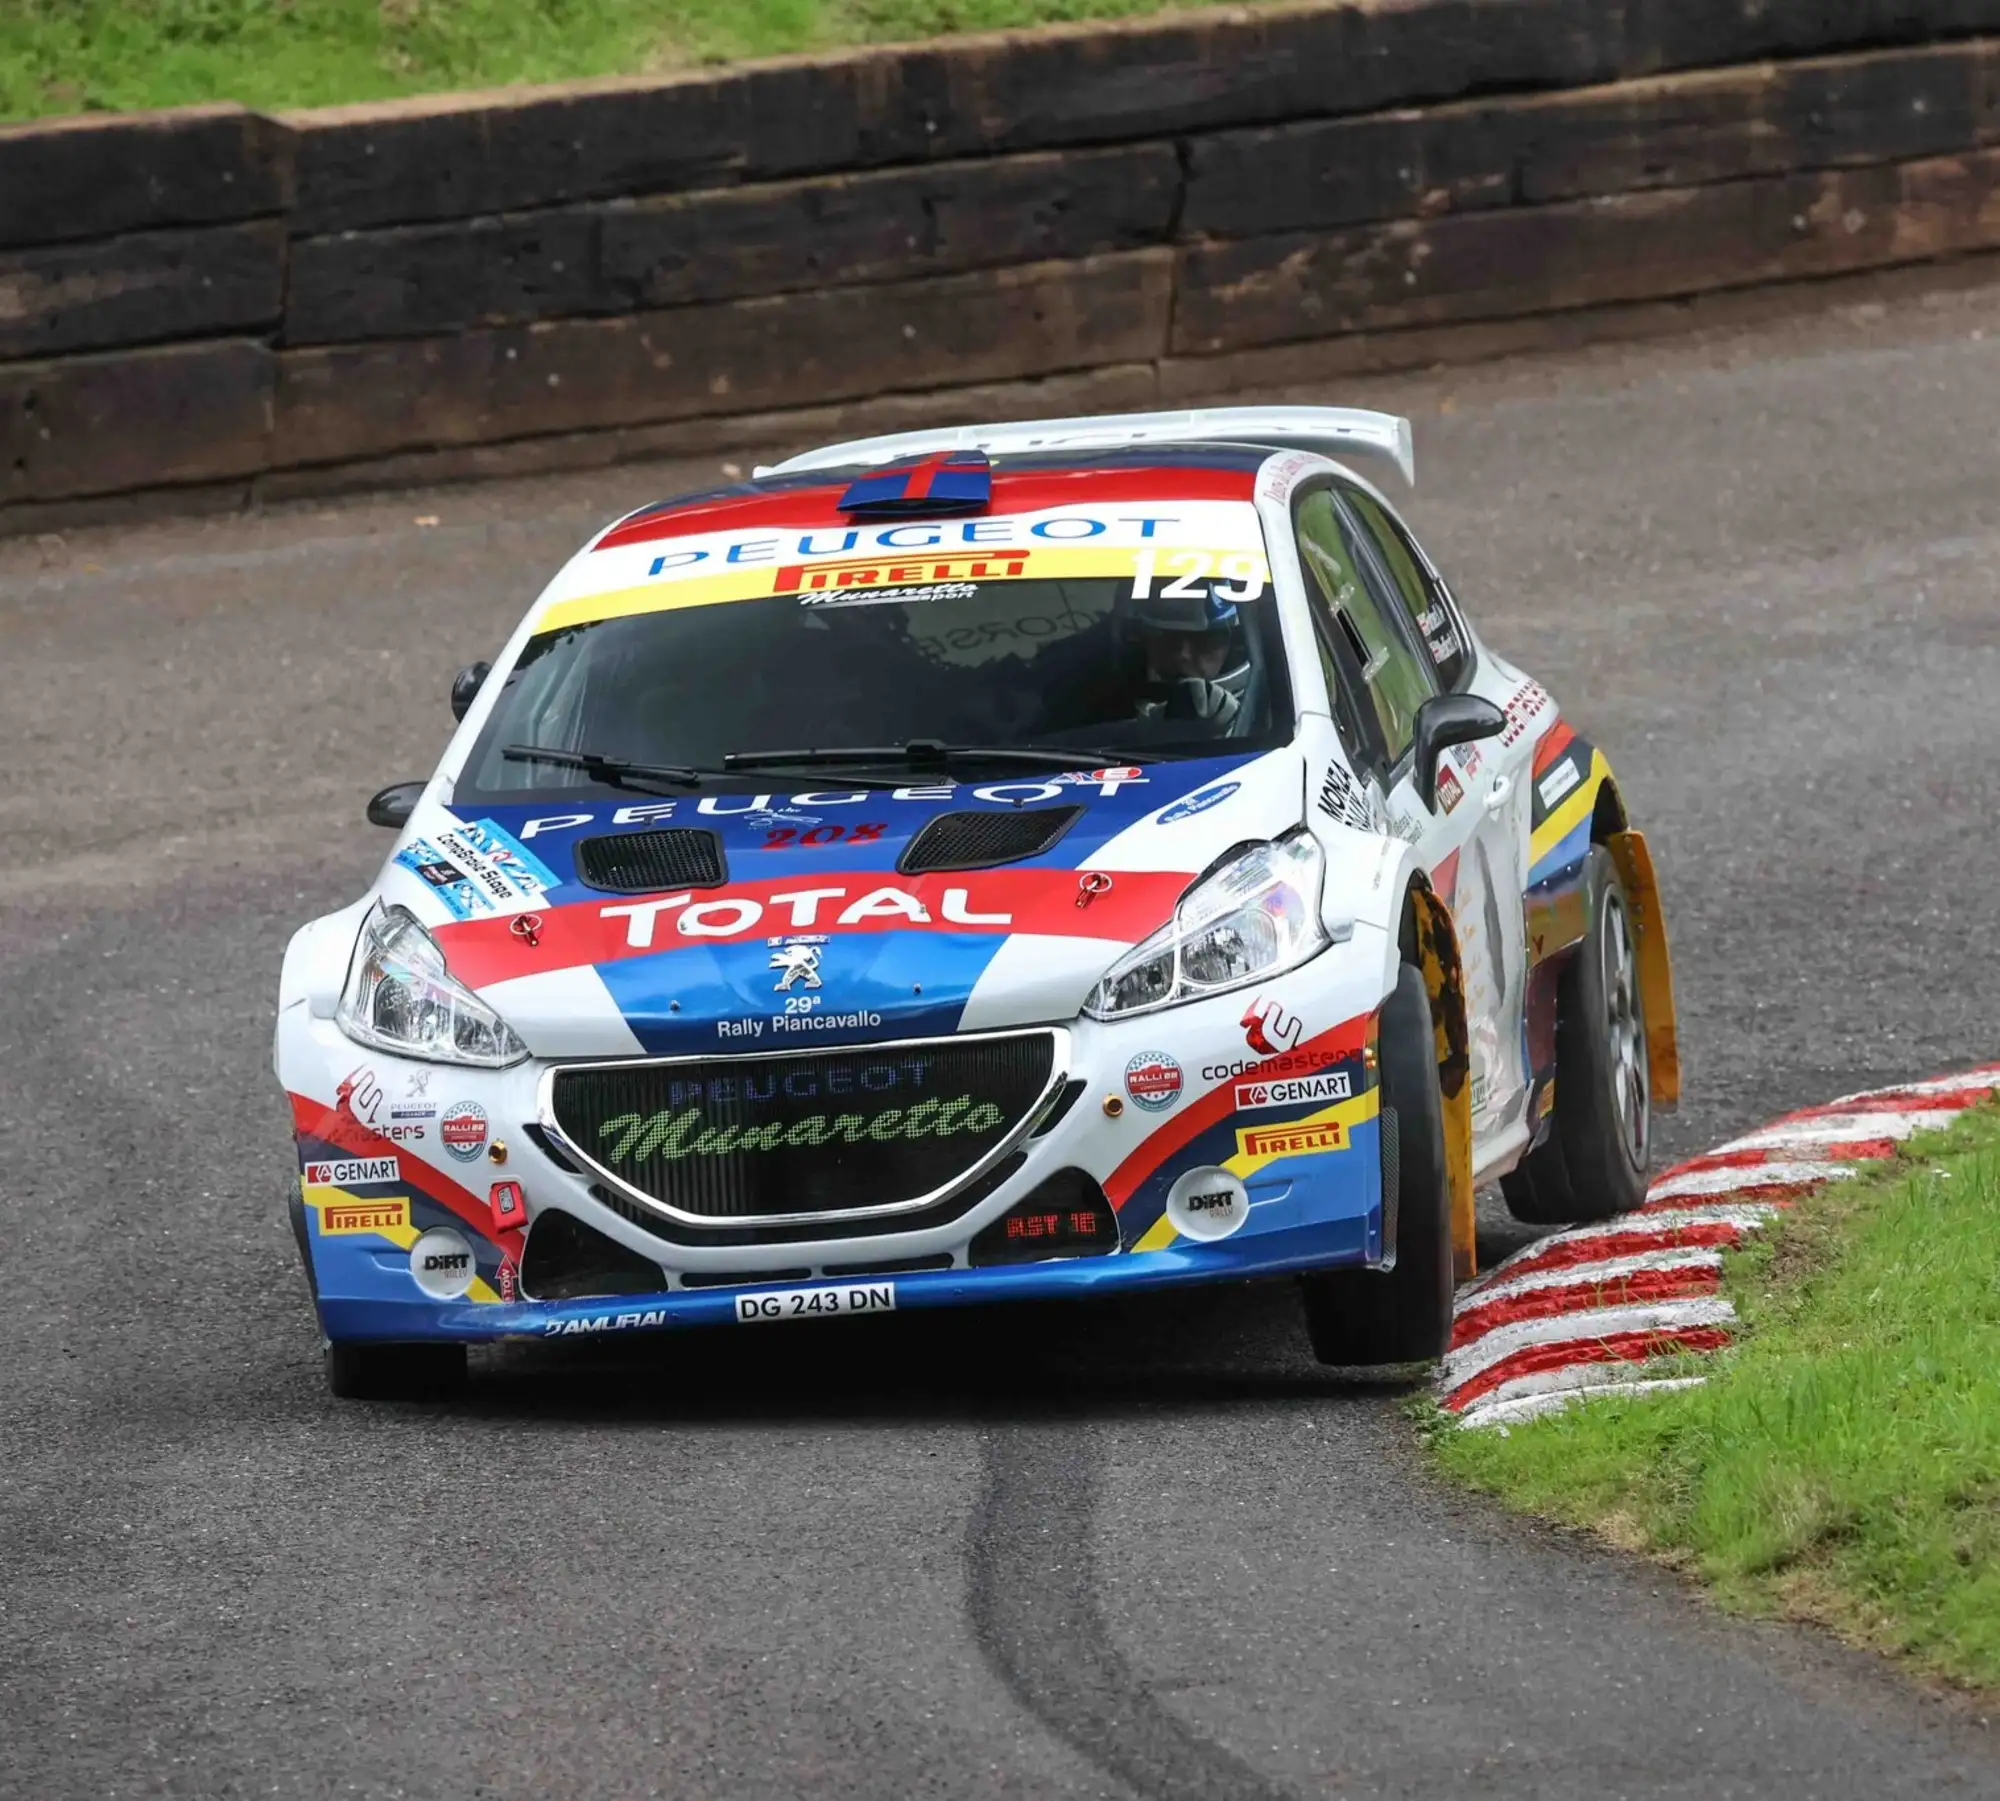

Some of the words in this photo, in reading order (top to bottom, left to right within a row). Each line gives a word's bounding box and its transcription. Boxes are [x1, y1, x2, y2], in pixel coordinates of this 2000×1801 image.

[648, 518, 1181, 576] PEUGEOT
[772, 549, 1030, 593] PIRELLI
[1131, 548, 1266, 602] 129
[797, 583, 979, 605] Munaretto
[1317, 758, 1352, 823] MONZA
[520, 778, 1150, 839] PEUGEOT
[761, 822, 889, 851] 208
[480, 870, 513, 899] Stage
[600, 887, 1012, 948] TOTAL
[717, 1018, 764, 1039] Rally
[772, 1010, 881, 1033] Piancavallo
[1201, 1047, 1362, 1081] codemasters
[669, 1060, 934, 1105] PEUGEOT
[1270, 1075, 1347, 1102] GENART
[598, 1094, 1005, 1163] Munaretto
[1244, 1122, 1341, 1156] PIRELLI
[334, 1160, 397, 1181] GENART
[325, 1203, 403, 1230] PIRELLI
[741, 1297, 781, 1319] DG
[791, 1292, 839, 1316] 243
[849, 1287, 890, 1310] DN
